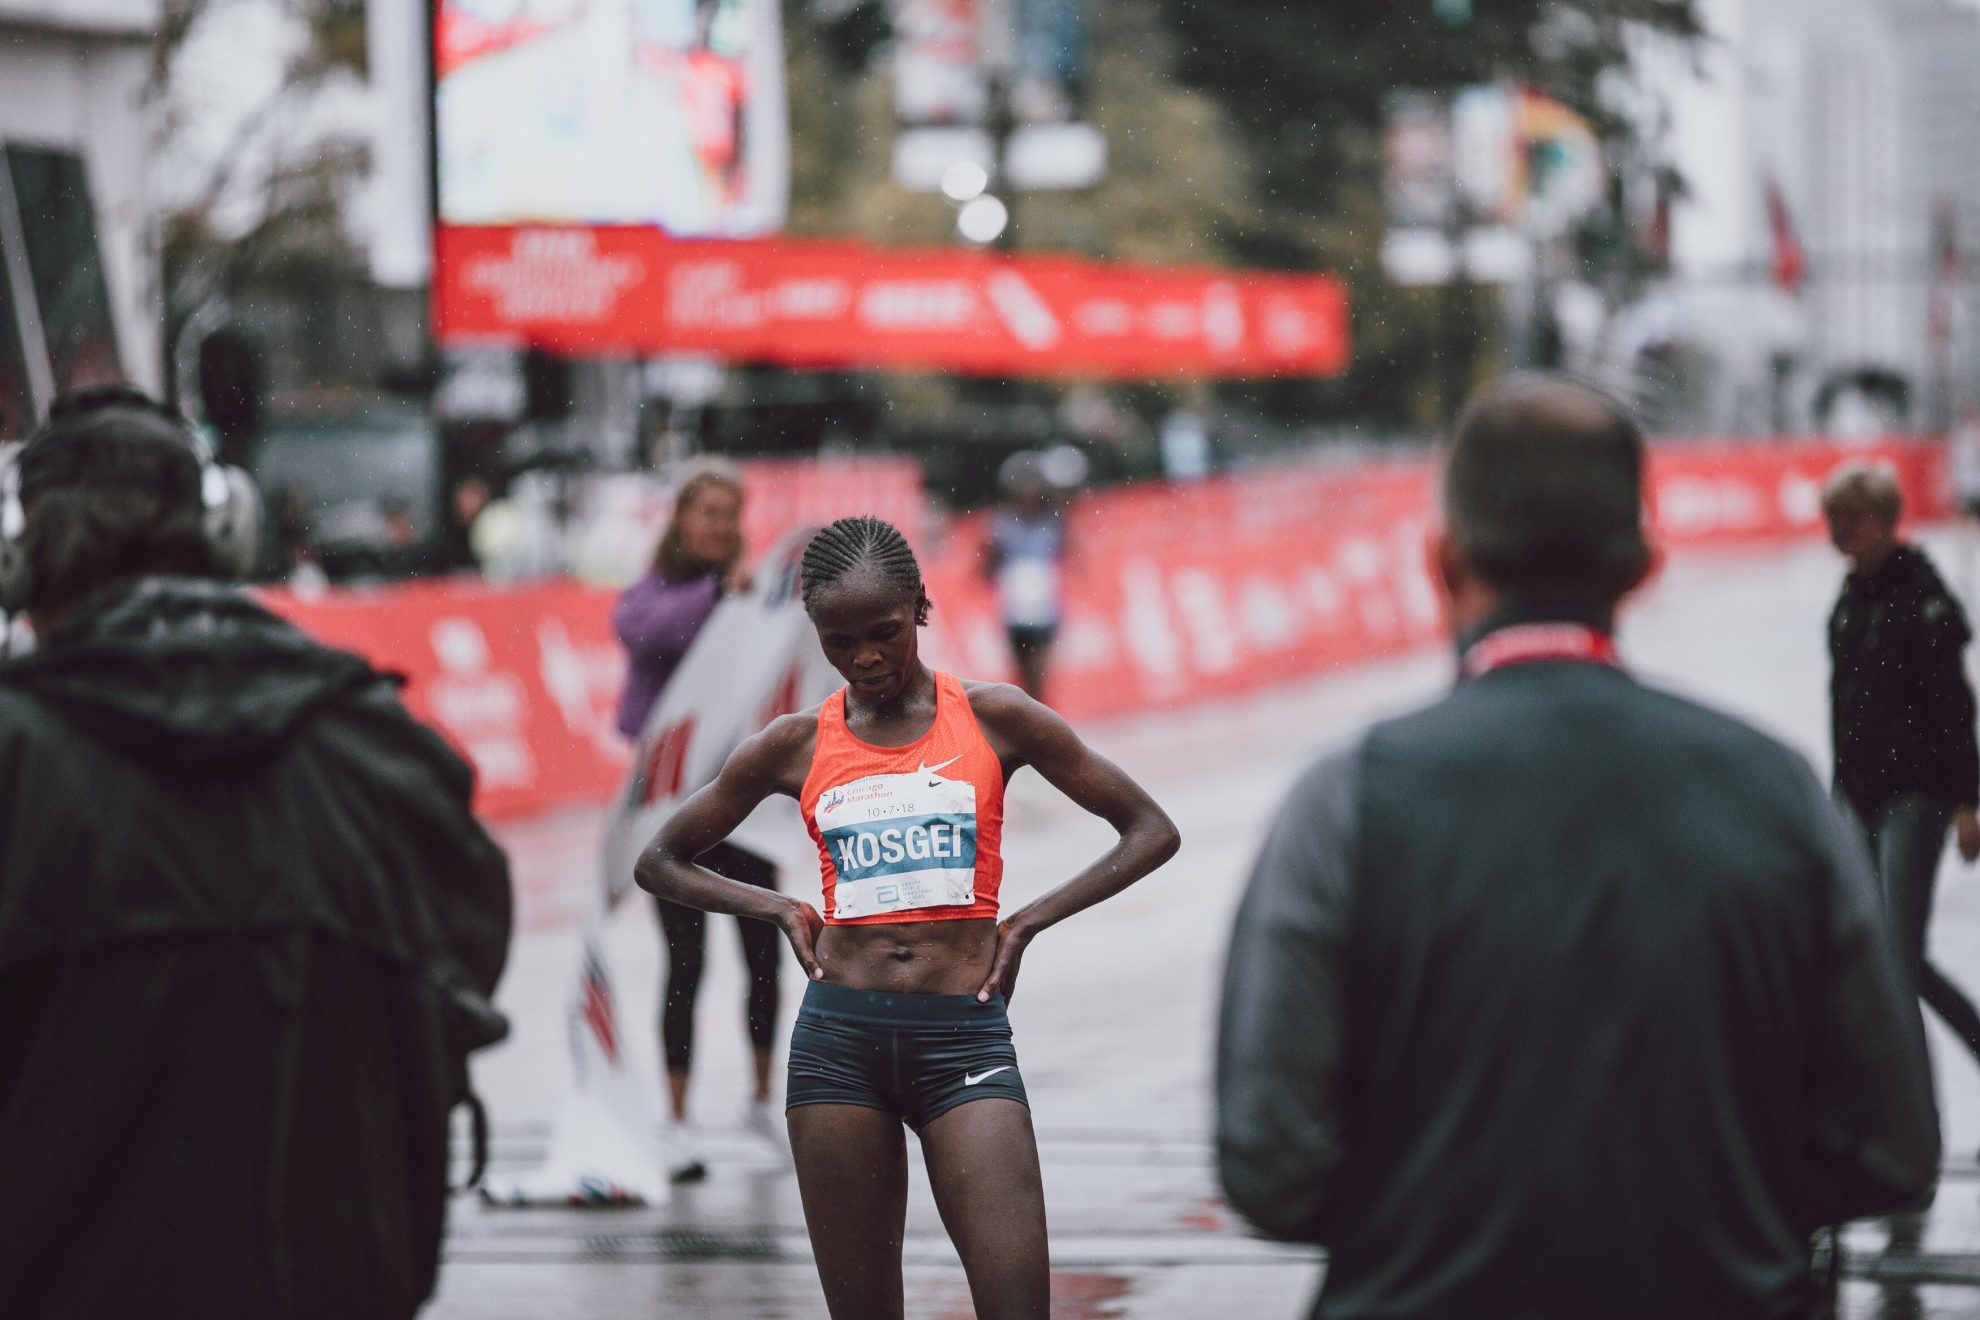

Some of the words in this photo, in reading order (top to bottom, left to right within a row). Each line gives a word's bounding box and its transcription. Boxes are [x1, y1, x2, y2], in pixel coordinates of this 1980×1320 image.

[847, 783, 883, 796] Chicago
[847, 791, 893, 804] Marathon
[837, 824, 961, 871] KOSGEI
